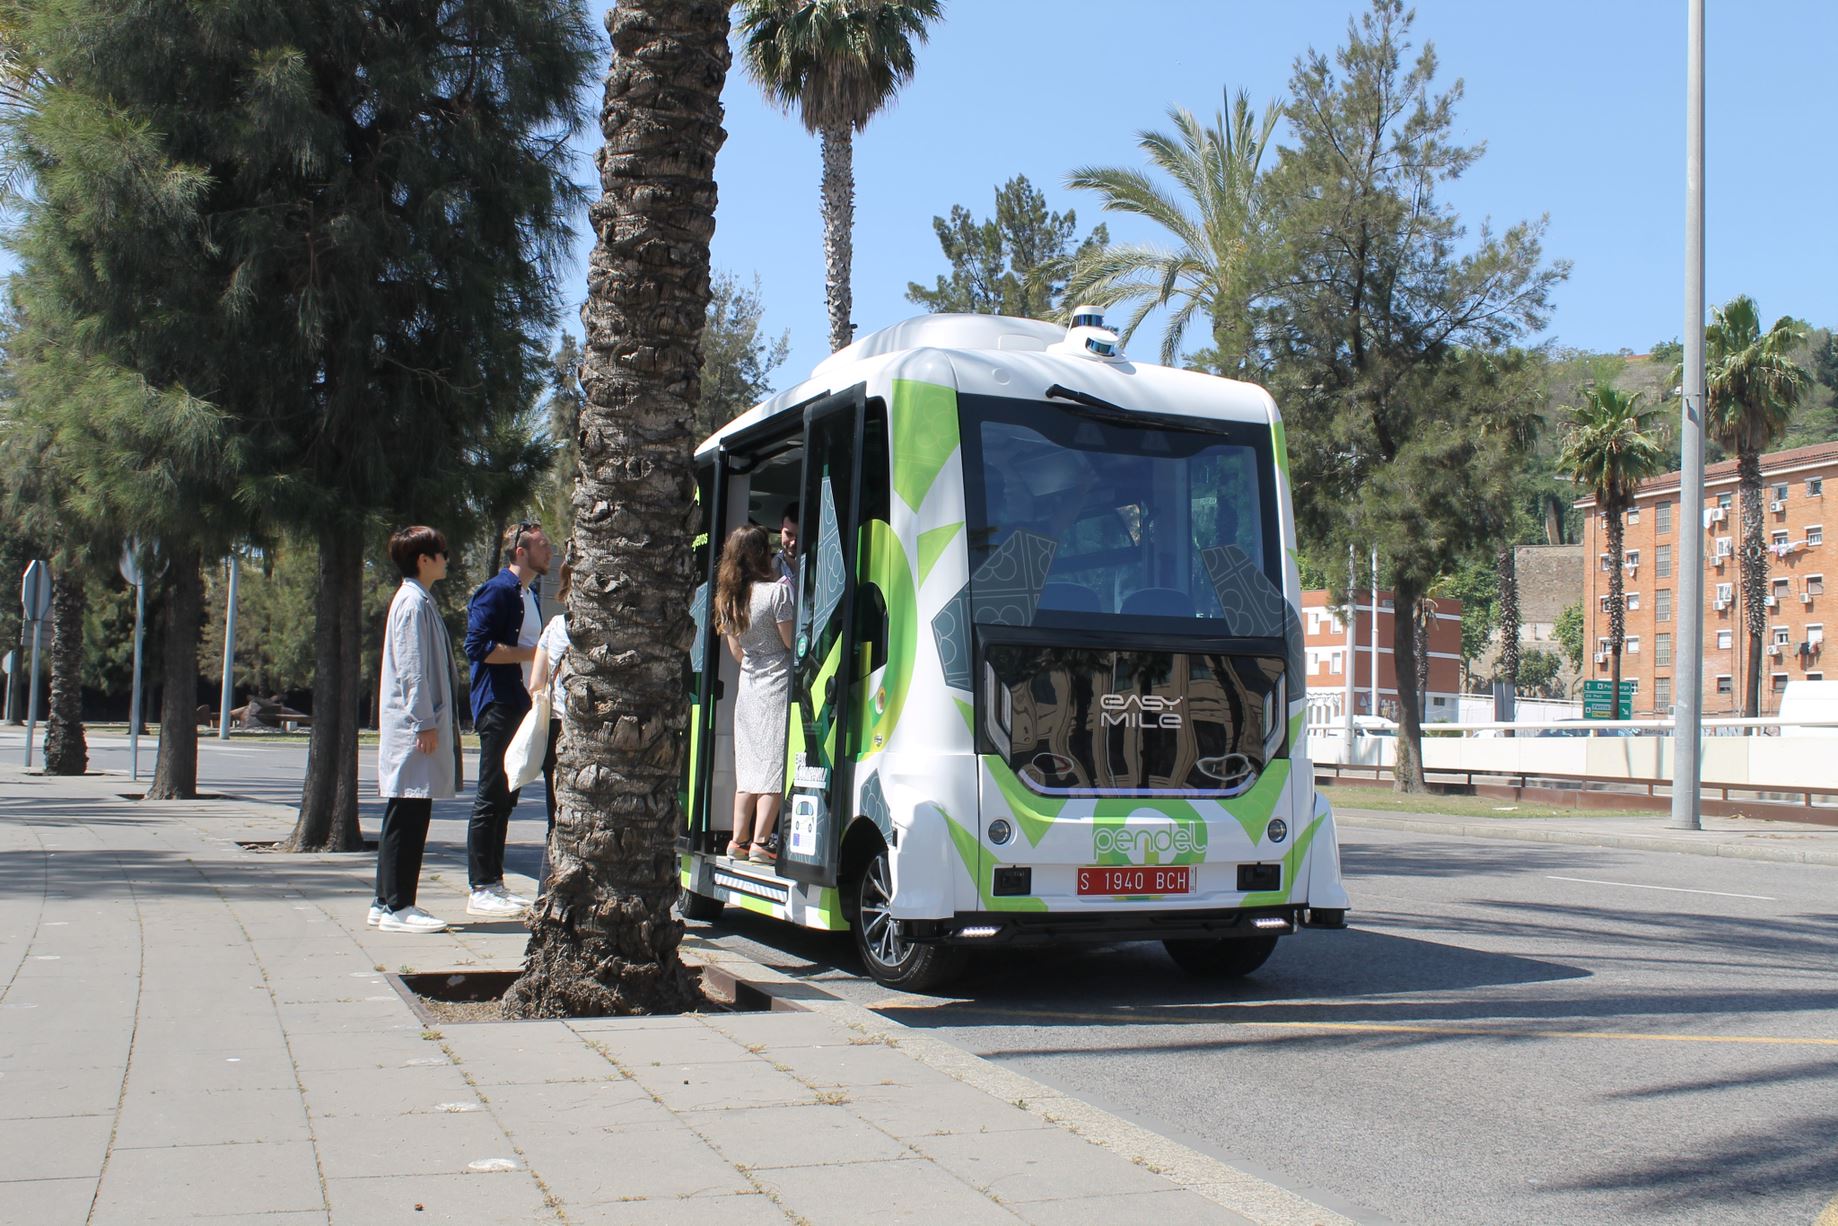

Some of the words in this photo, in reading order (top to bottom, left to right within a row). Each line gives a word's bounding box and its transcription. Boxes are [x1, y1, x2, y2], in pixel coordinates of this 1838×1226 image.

[1093, 820, 1208, 861] pendel
[1080, 872, 1090, 890] S
[1104, 872, 1144, 890] 1940
[1156, 871, 1186, 890] BCH
